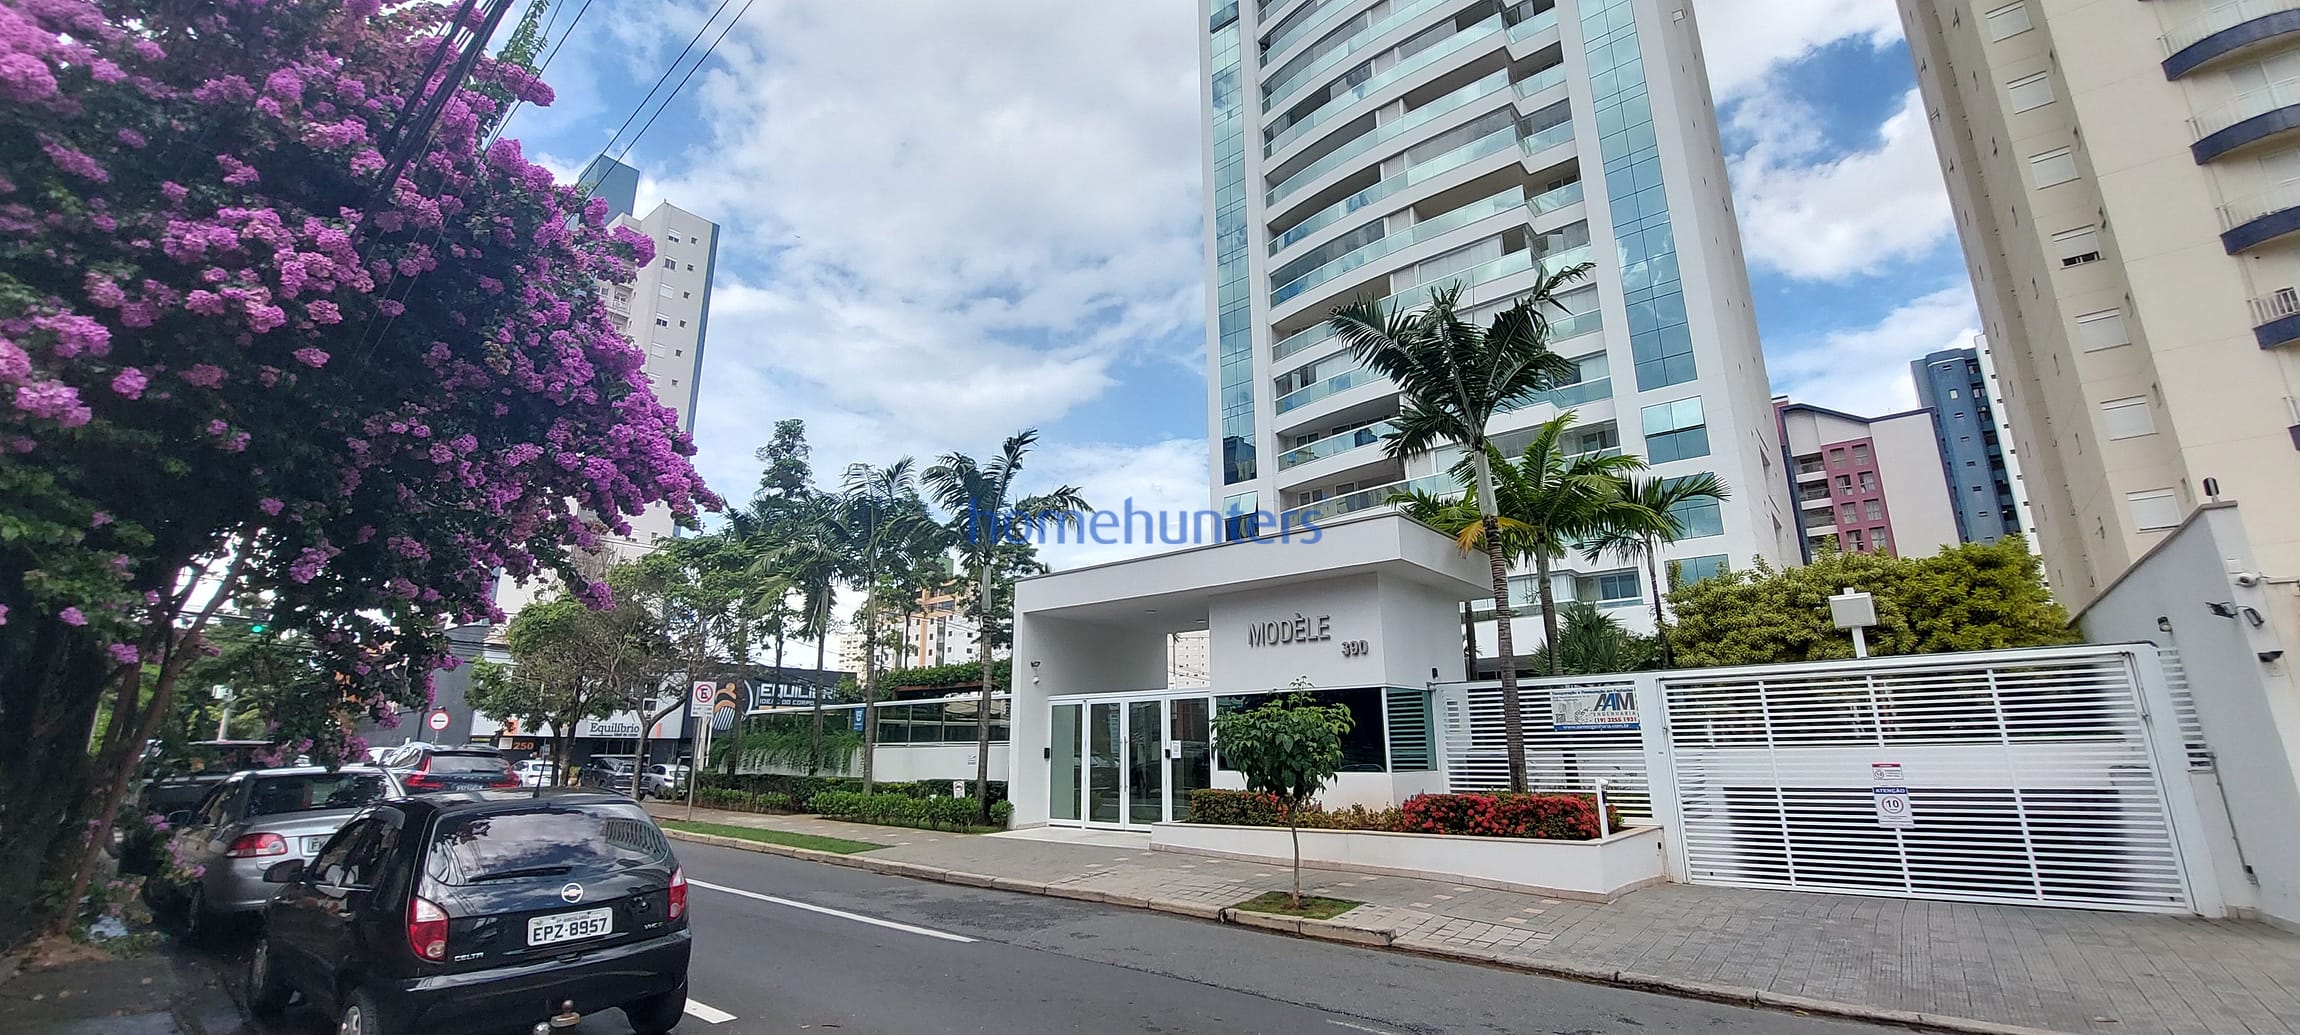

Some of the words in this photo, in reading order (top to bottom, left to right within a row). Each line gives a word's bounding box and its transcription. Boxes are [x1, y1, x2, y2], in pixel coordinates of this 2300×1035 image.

[1247, 610, 1331, 648] MODÈLE
[1341, 640, 1369, 657] 390
[1593, 693, 1636, 711] AAM
[513, 742, 535, 750] 250
[1886, 800, 1899, 808] 10
